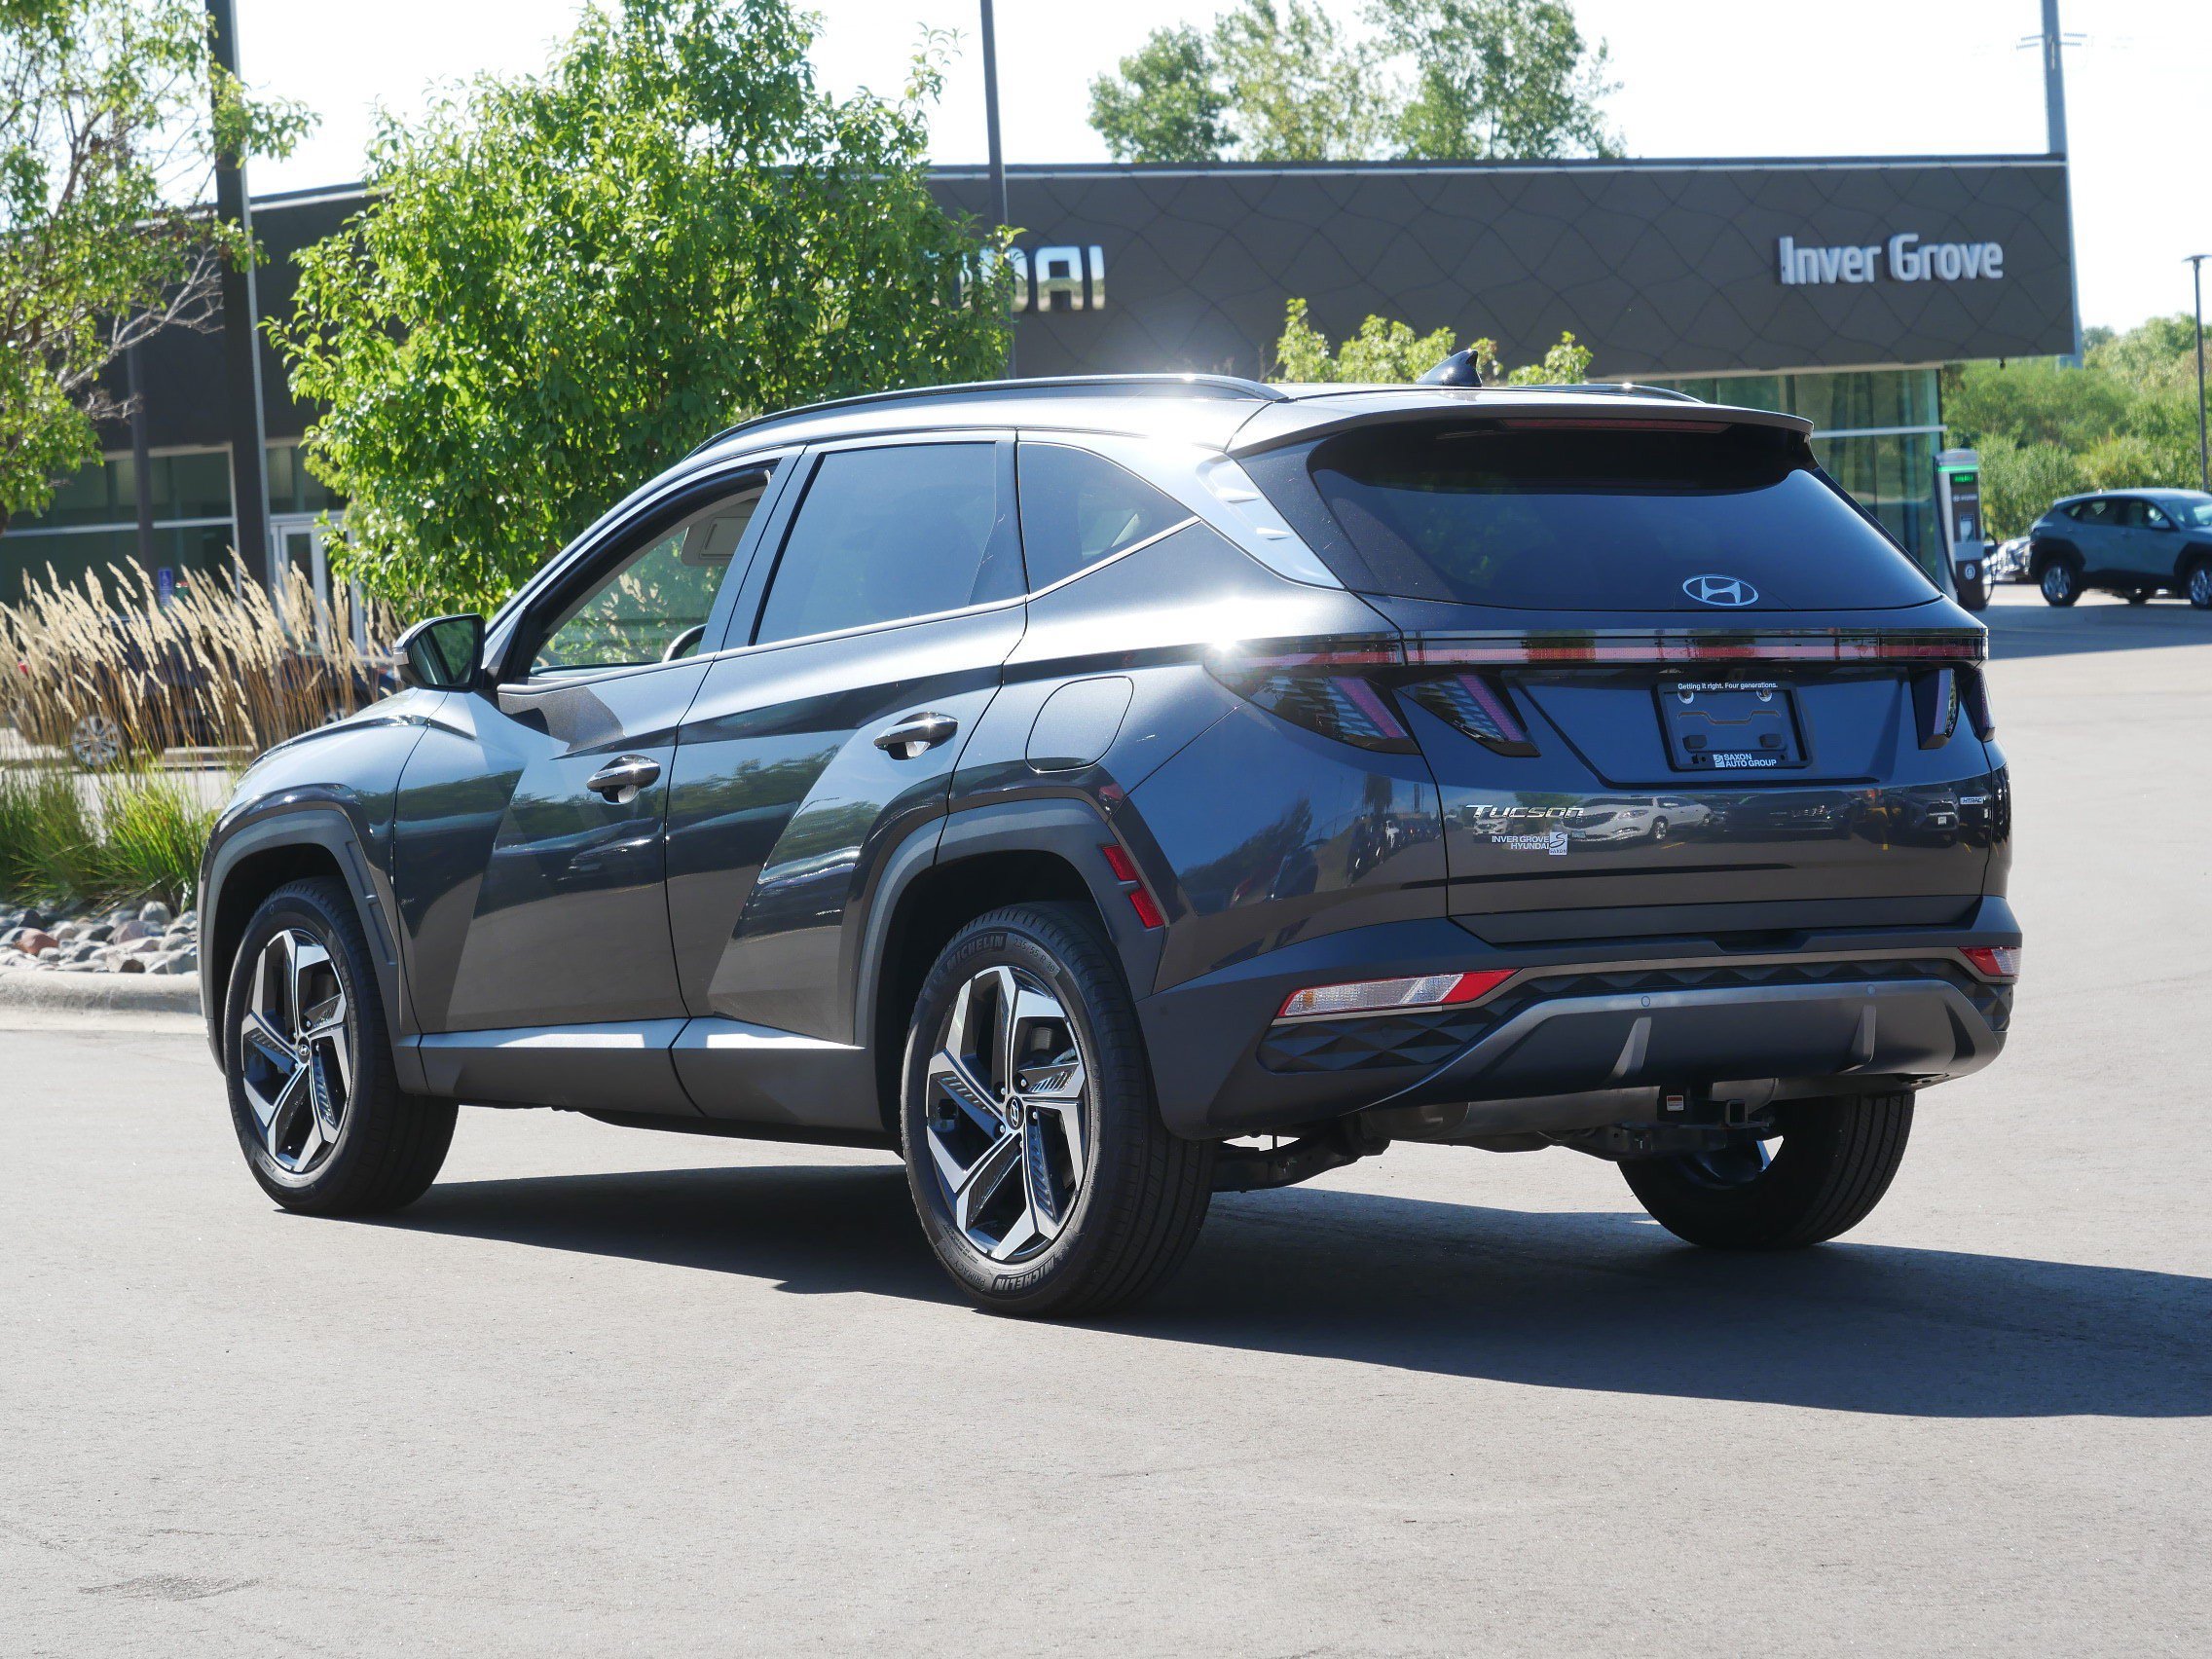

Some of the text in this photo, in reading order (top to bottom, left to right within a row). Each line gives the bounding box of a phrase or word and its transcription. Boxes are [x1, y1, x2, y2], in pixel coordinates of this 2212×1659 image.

[1779, 233, 2004, 284] Inver Grove
[946, 936, 1004, 972] MICHELIN
[953, 1261, 986, 1286] PRIMACY
[995, 1255, 1054, 1291] MICHELIN
